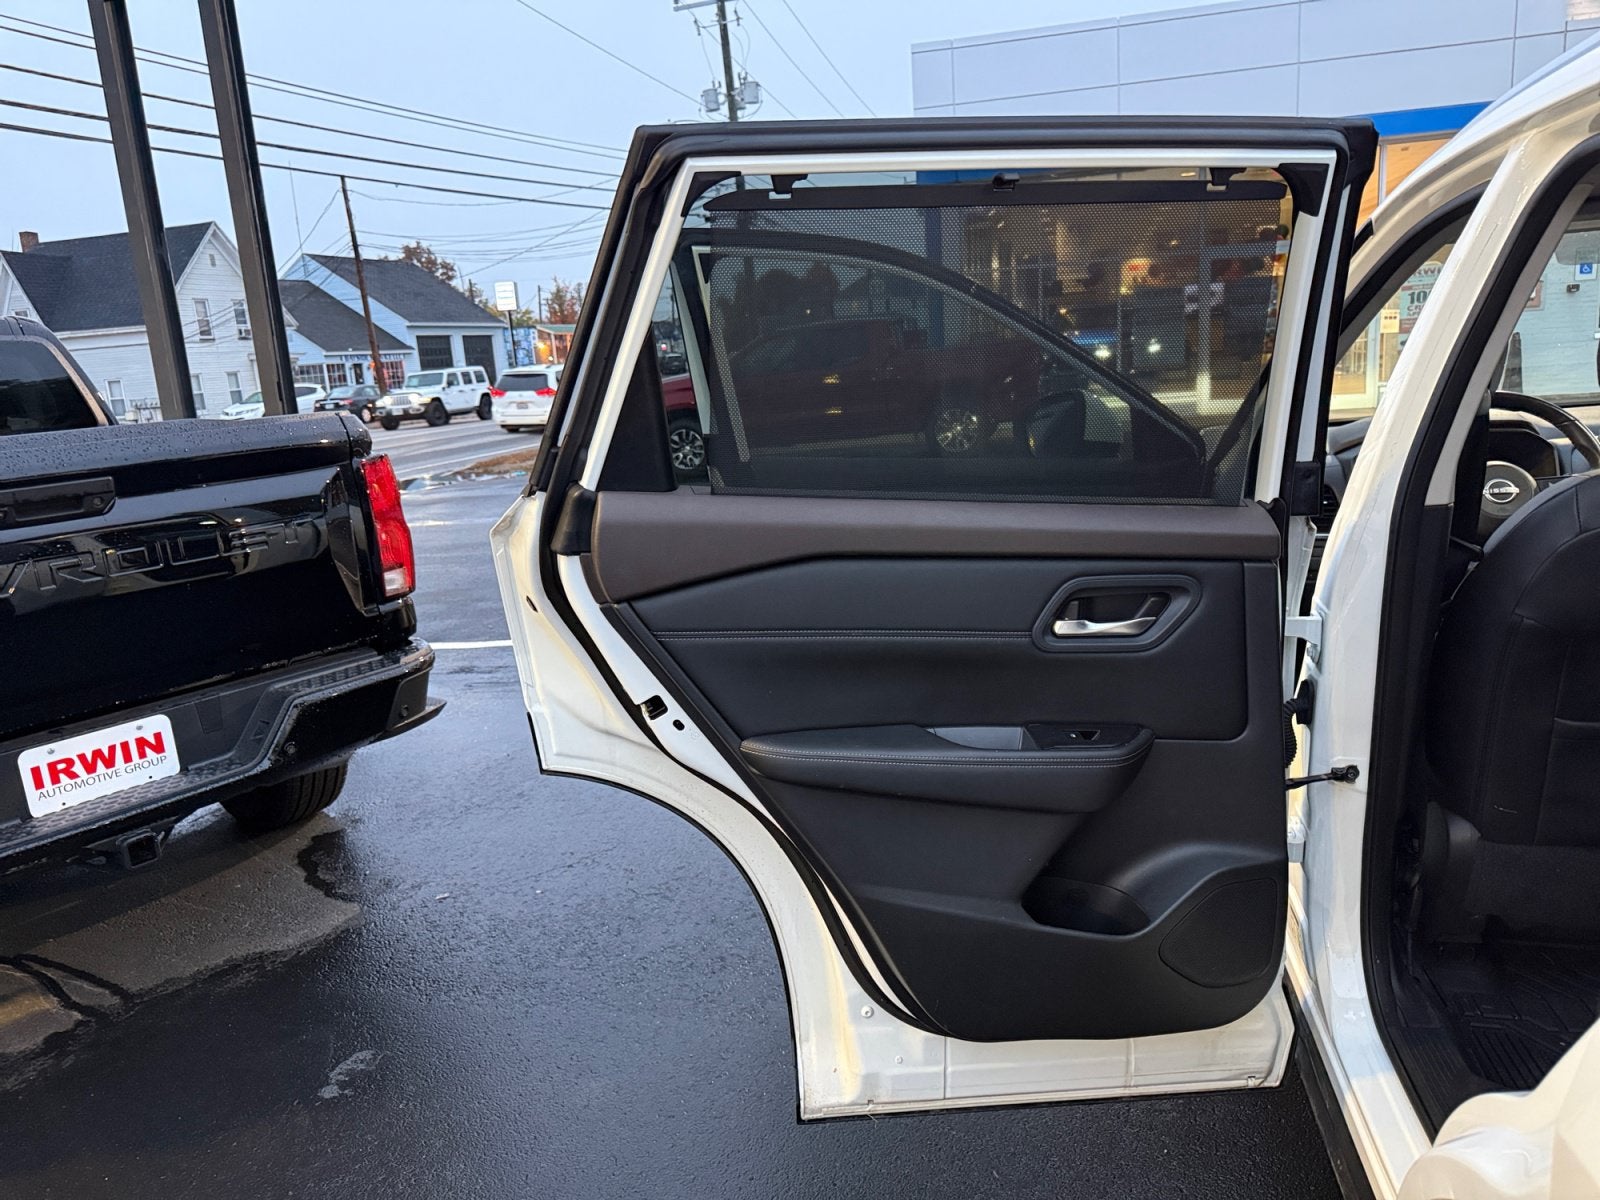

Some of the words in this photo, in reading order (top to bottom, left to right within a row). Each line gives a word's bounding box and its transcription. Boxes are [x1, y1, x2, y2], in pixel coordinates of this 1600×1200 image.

[30, 731, 166, 791] IRWIN
[38, 768, 121, 801] AUTOMOTIVE
[124, 755, 167, 774] GROUP
